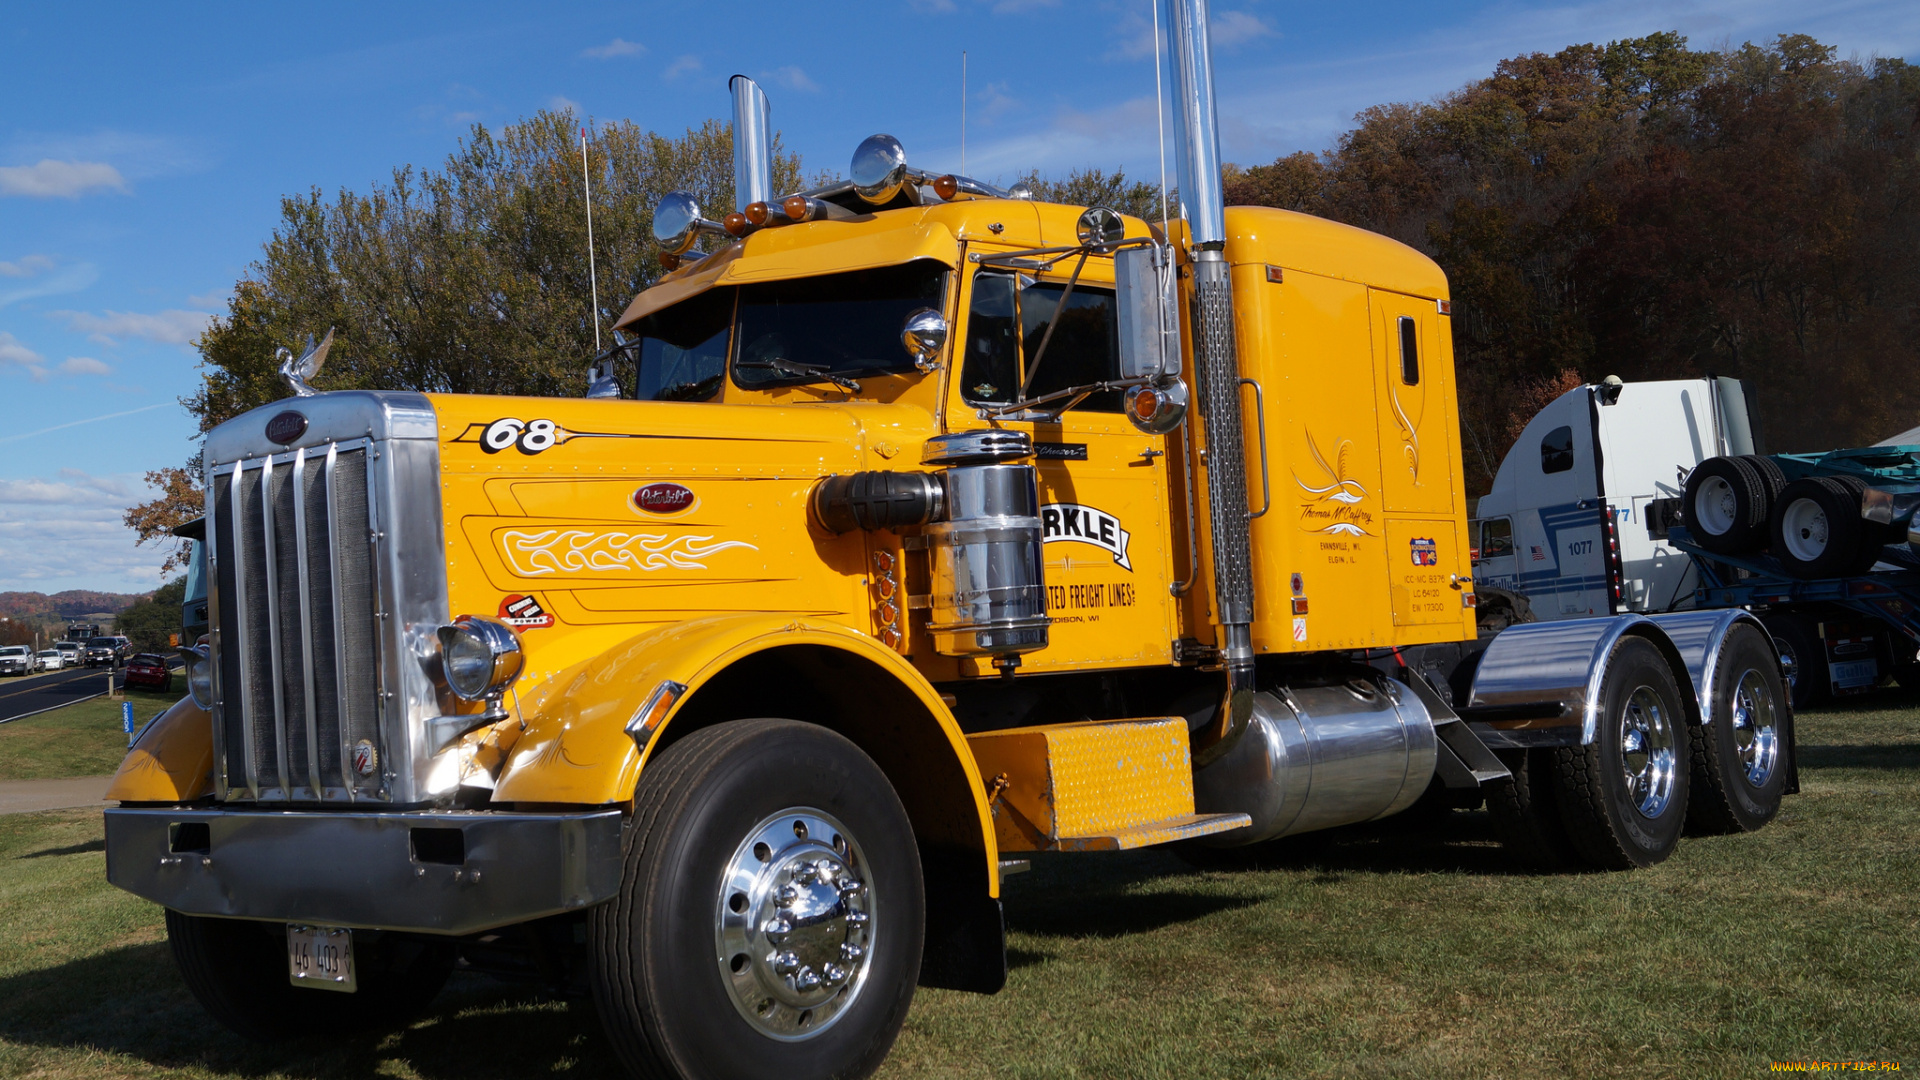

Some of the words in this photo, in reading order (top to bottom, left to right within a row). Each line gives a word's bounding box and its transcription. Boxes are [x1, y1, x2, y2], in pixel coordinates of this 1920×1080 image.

[269, 417, 302, 438] Peterbilt
[479, 417, 556, 456] 68
[641, 488, 690, 506] Peterbilt
[1300, 504, 1331, 521] Thomas
[1041, 507, 1117, 549] RKLE
[1320, 542, 1350, 553] EVANSVILLE,
[1568, 539, 1592, 556] 1077
[1069, 583, 1105, 609] FREIGHT
[1108, 582, 1132, 607] LINES
[1423, 602, 1444, 612] 17300
[295, 942, 309, 970] 46
[317, 944, 340, 973] 403
